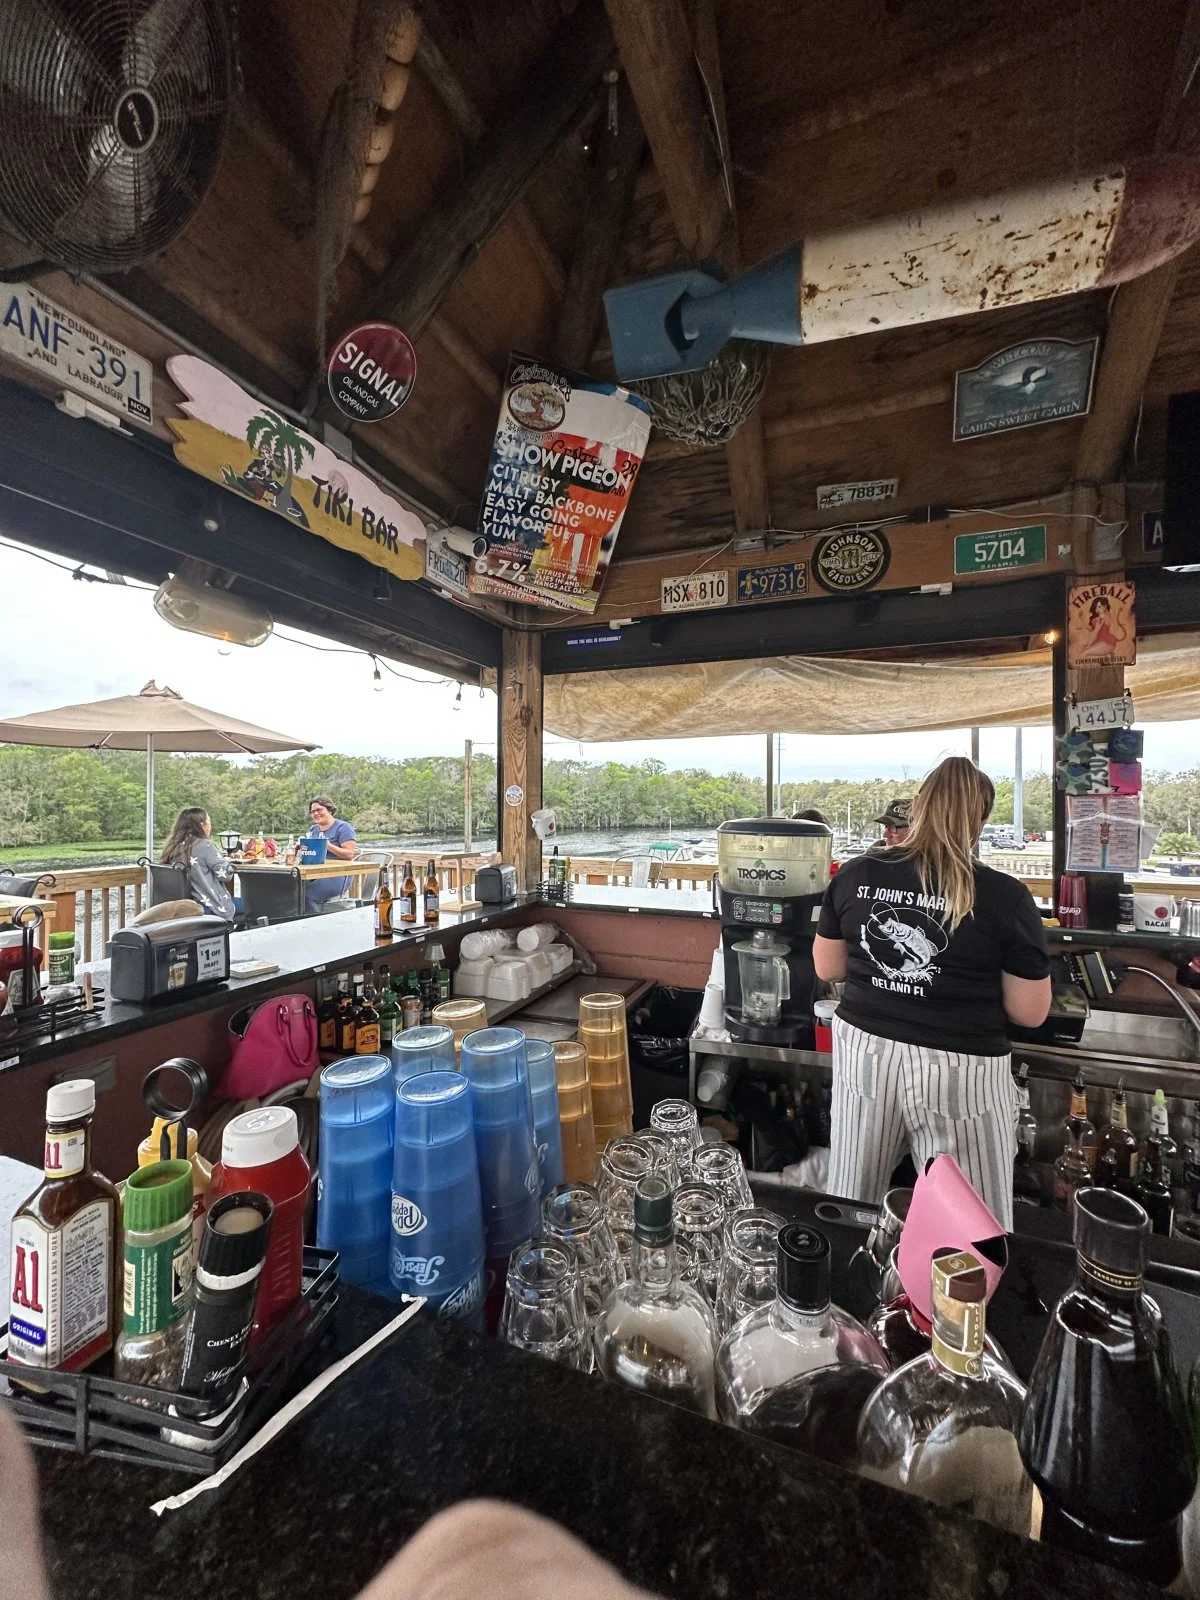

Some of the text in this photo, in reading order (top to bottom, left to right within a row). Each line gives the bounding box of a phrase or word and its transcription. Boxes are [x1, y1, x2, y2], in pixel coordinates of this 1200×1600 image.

[37, 297, 122, 357] NEWFOUNDLAND
[3, 295, 140, 400] ANF-391
[33, 348, 125, 402] AND LABRADOR
[338, 342, 404, 407] SIGNAL
[338, 390, 368, 415] COMPANY
[342, 376, 379, 408] OIL AND GAS
[130, 400, 148, 414] NOV
[960, 421, 998, 434] CABIN
[998, 412, 1039, 426] SWEET
[1041, 401, 1081, 420] CABIN
[496, 437, 633, 491] SHOW PIGEON
[492, 463, 561, 493] CITRUSY
[485, 492, 581, 528] EASY GOING
[488, 478, 532, 500] MALT
[535, 490, 617, 523] BACKBONE
[311, 474, 399, 555] TIKI BAR
[482, 507, 571, 542] FLAVORFUL
[482, 520, 517, 541] YUM
[827, 534, 876, 556] JOHNSON
[974, 537, 1026, 563] 5704
[474, 555, 528, 583] 6.7%
[536, 567, 578, 582] CITRUSY IPA
[755, 566, 789, 576] ALASKA
[827, 564, 874, 584] GASOLENE
[980, 560, 1019, 570] BAHAMAS
[495, 581, 512, 590] AND
[533, 580, 587, 595] HANGS ALL DAY
[535, 574, 555, 584] FLIES
[563, 579, 580, 588] AND
[663, 579, 725, 604] MSX 810
[760, 570, 806, 594] 97316
[1072, 585, 1131, 609] FIREBALL
[1076, 708, 1128, 727] 144J7
[736, 867, 786, 881] TROPICS
[738, 879, 787, 887] MIXOLOGY
[856, 885, 870, 899] ST.
[872, 887, 915, 905] JOHN'S
[211, 949, 221, 957] OFF
[203, 960, 219, 969] DRAFT
[871, 976, 927, 998] DELAND FL
[50, 1234, 58, 1257] MORE
[50, 1259, 58, 1275] AND
[1093, 1269, 1122, 1285] PRODUCT
[12, 1245, 44, 1314] A1
[50, 1277, 58, 1313] BURGERS
[12, 1322, 42, 1341] ORIGINAL
[17, 1339, 36, 1353] SAUCE
